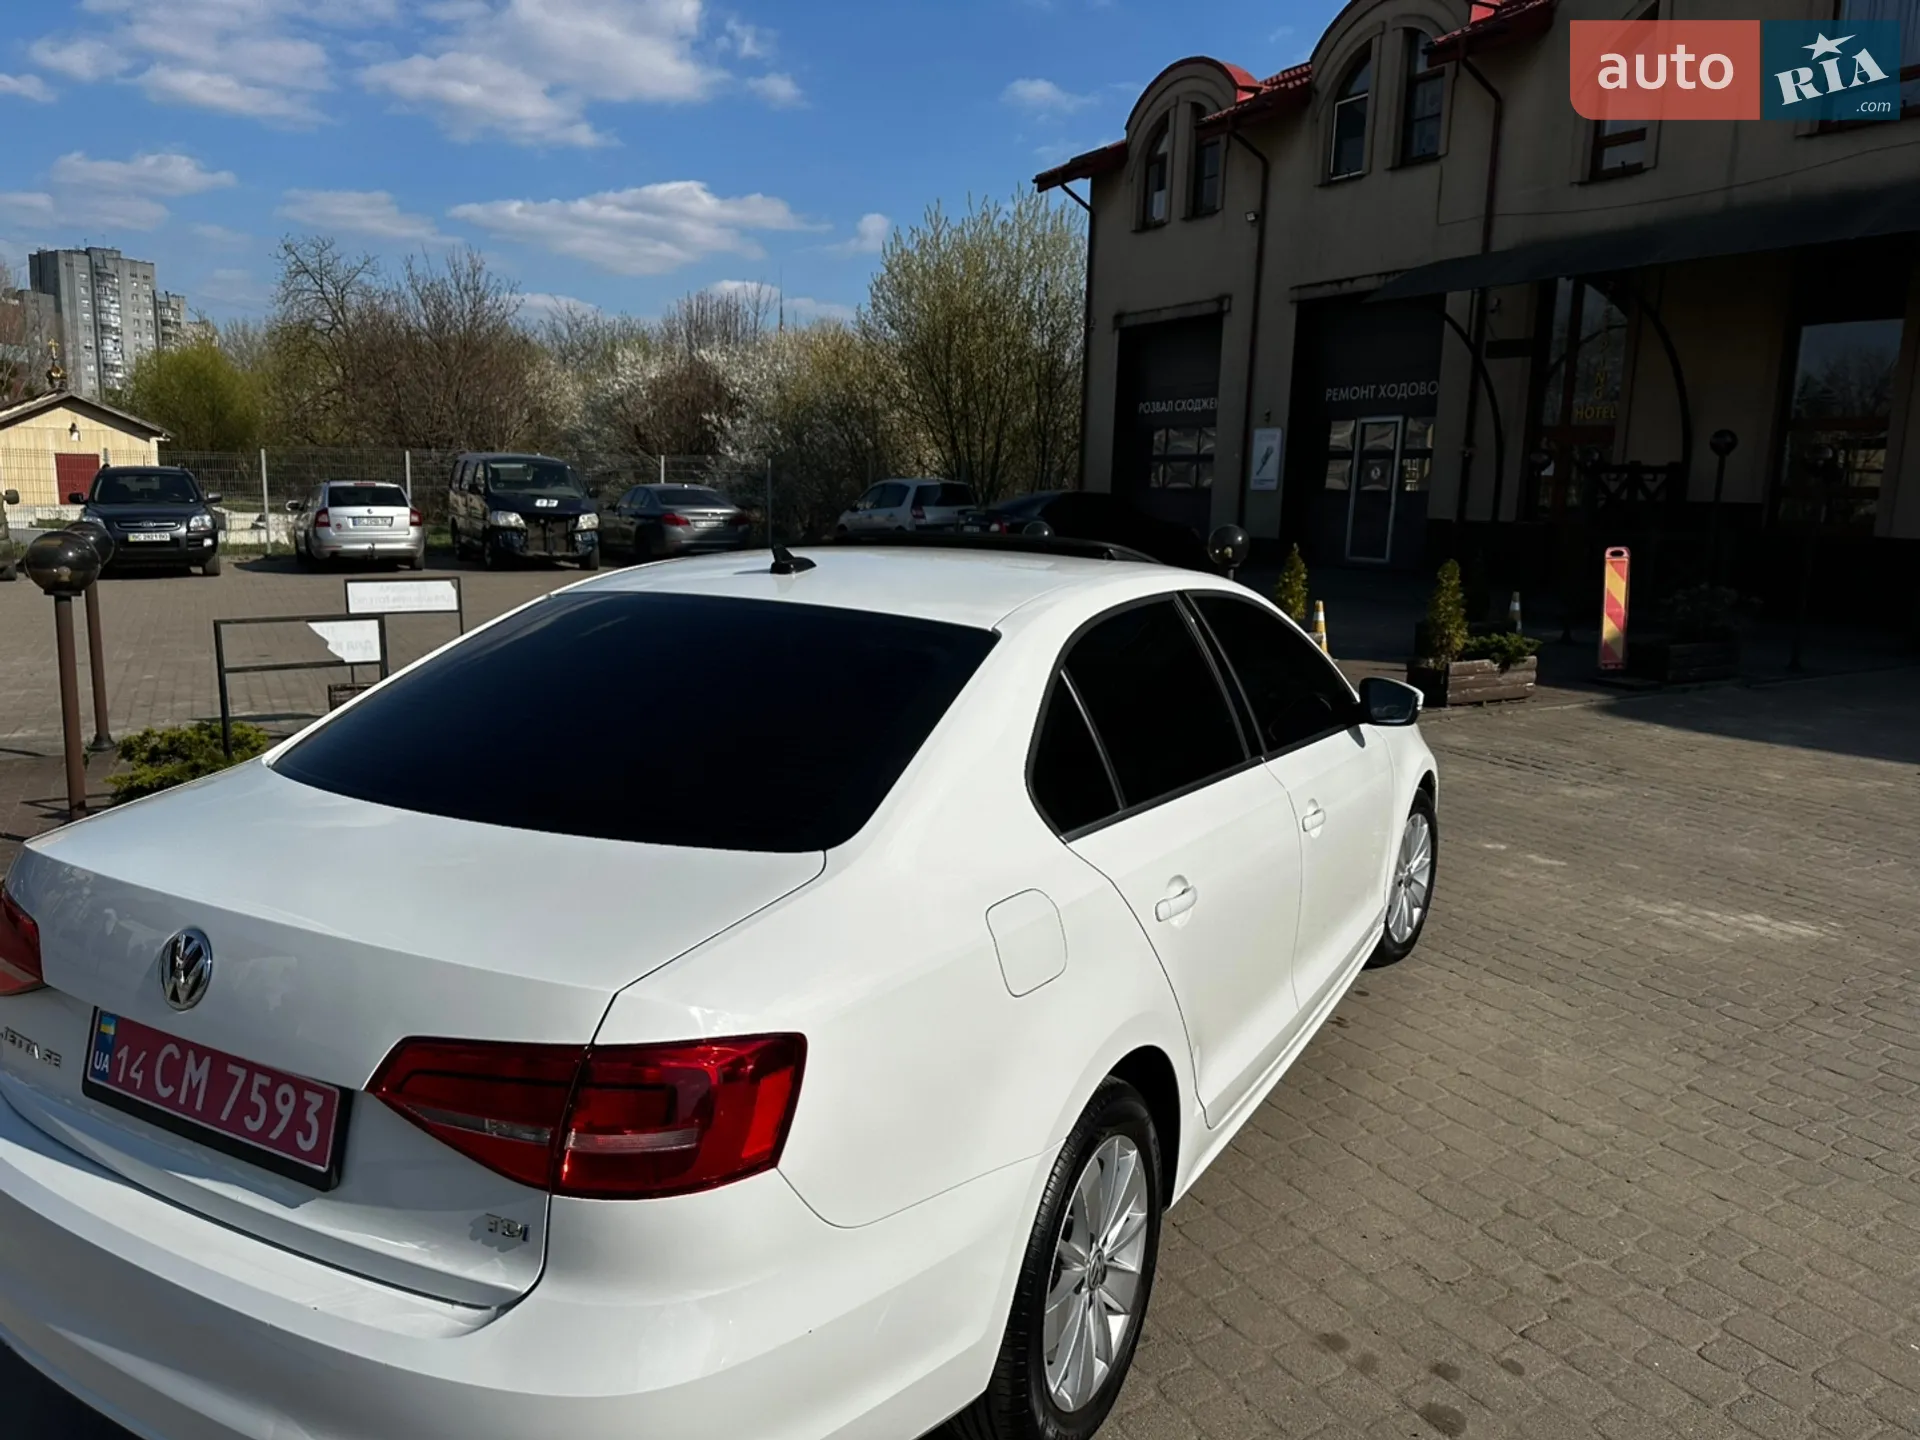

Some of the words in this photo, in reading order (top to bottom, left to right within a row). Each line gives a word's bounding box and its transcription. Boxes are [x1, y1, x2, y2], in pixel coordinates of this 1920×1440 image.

[1325, 384, 1376, 403] РЕМОНТ
[1378, 380, 1440, 401] ХОДОВО
[1138, 400, 1174, 416] РОЗВАЛ
[1575, 405, 1617, 420] HOTEL
[93, 1050, 110, 1073] UA
[117, 1044, 147, 1091] 14
[154, 1043, 211, 1112] CM
[219, 1065, 326, 1152] 7593
